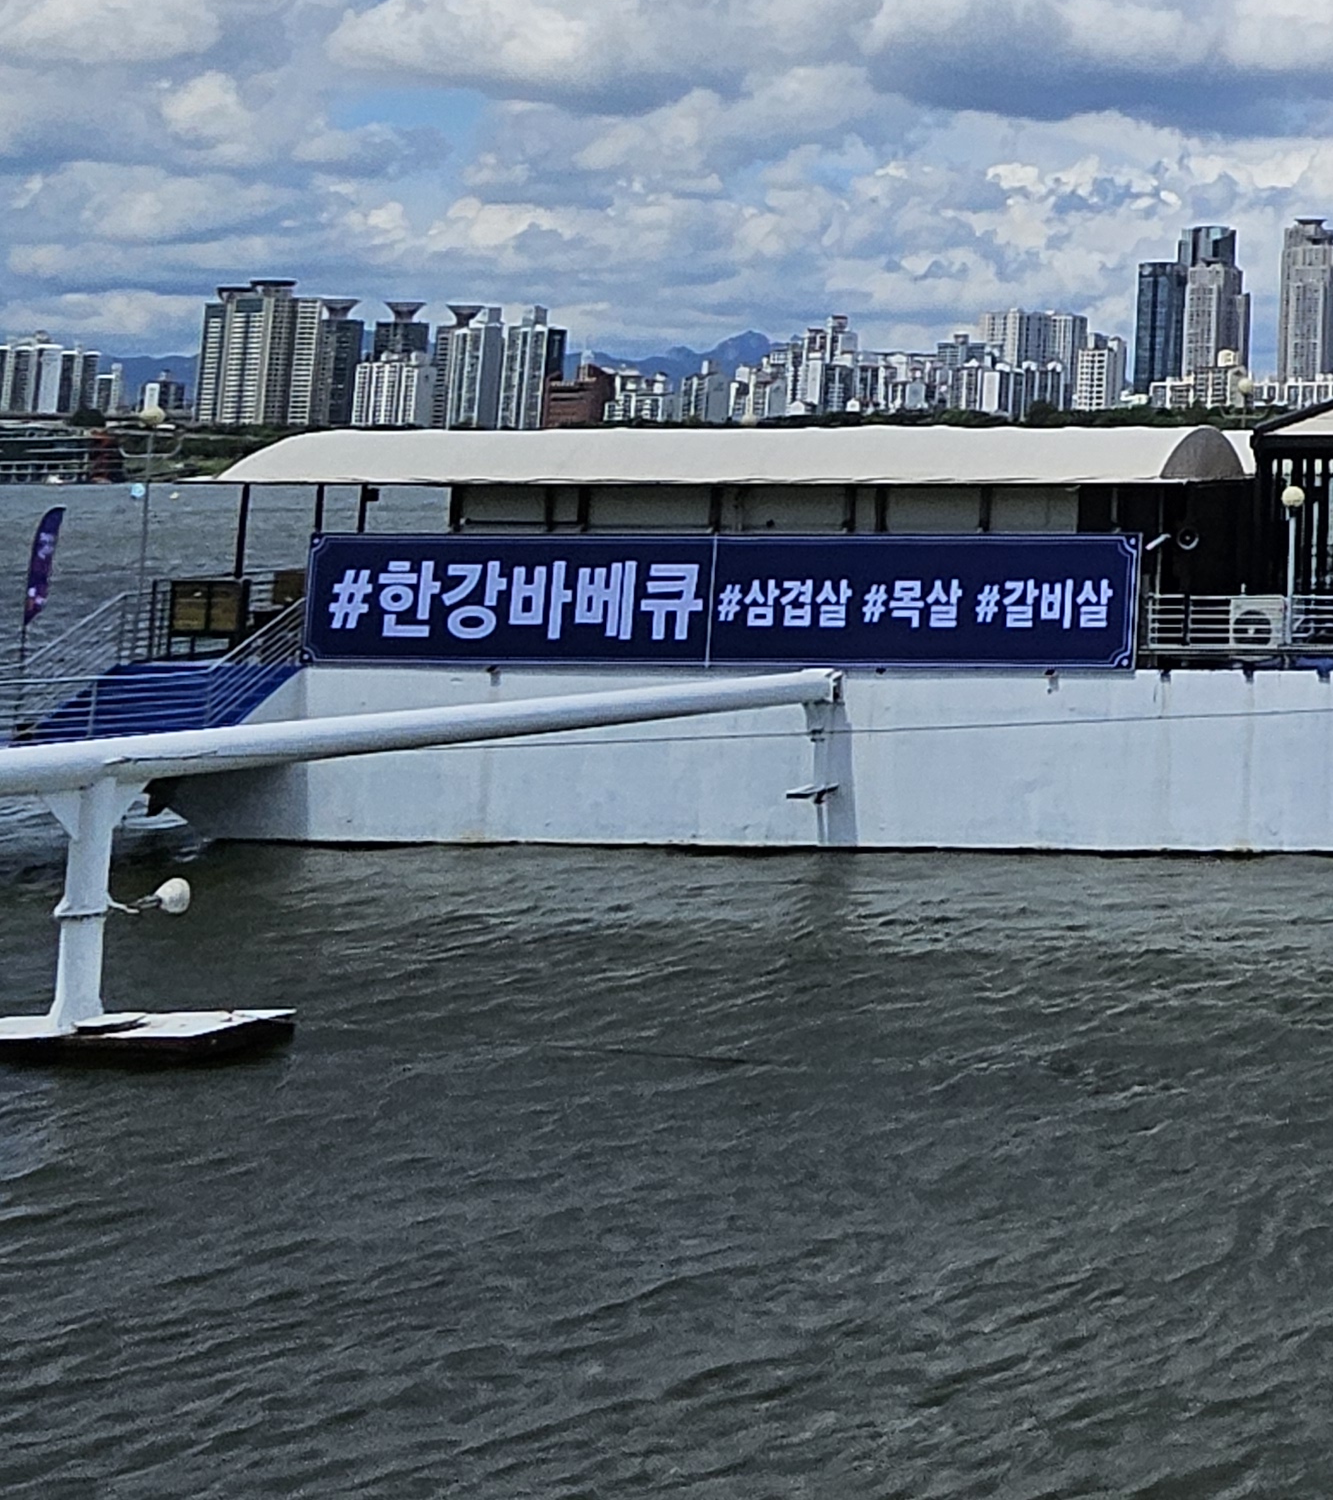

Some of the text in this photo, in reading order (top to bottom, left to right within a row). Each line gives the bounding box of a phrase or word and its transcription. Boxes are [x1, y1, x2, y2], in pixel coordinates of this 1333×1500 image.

[328, 560, 1113, 640] #한강바베큐 #삼겹살 #목살 #갈비살
